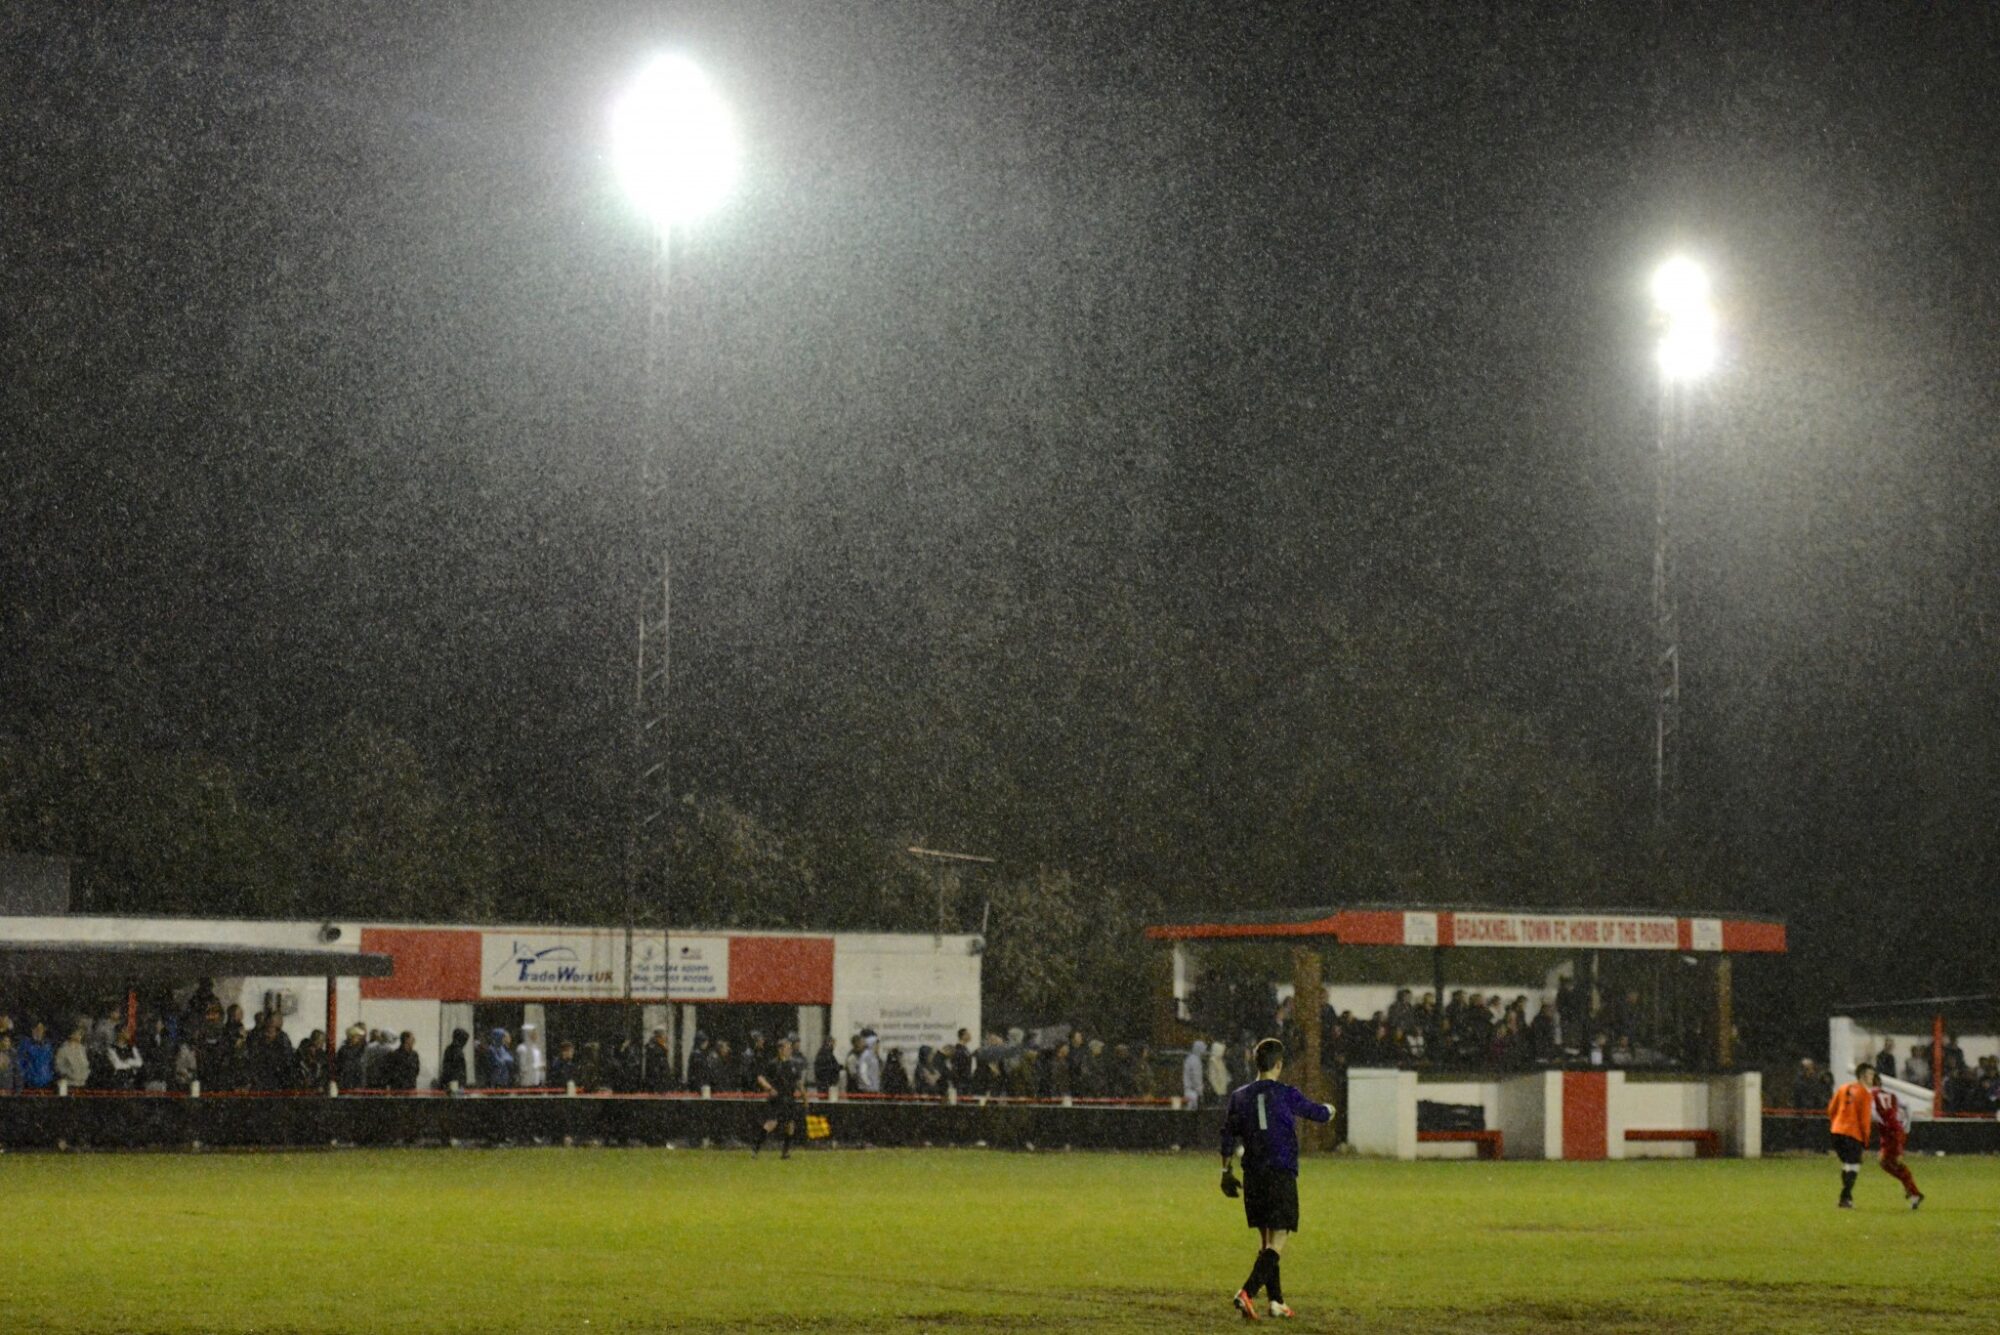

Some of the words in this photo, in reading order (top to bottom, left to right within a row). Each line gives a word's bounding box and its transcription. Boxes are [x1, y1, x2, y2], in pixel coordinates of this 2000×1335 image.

[1456, 918, 1518, 942] BRACKNELL
[1521, 919, 1551, 943] TOWN
[1554, 920, 1567, 943] FC
[1570, 920, 1599, 943] HOME
[1603, 921, 1615, 943] OF
[1618, 921, 1637, 944] THE
[1640, 922, 1676, 944] ROBINS
[1257, 1093, 1268, 1130] 1
